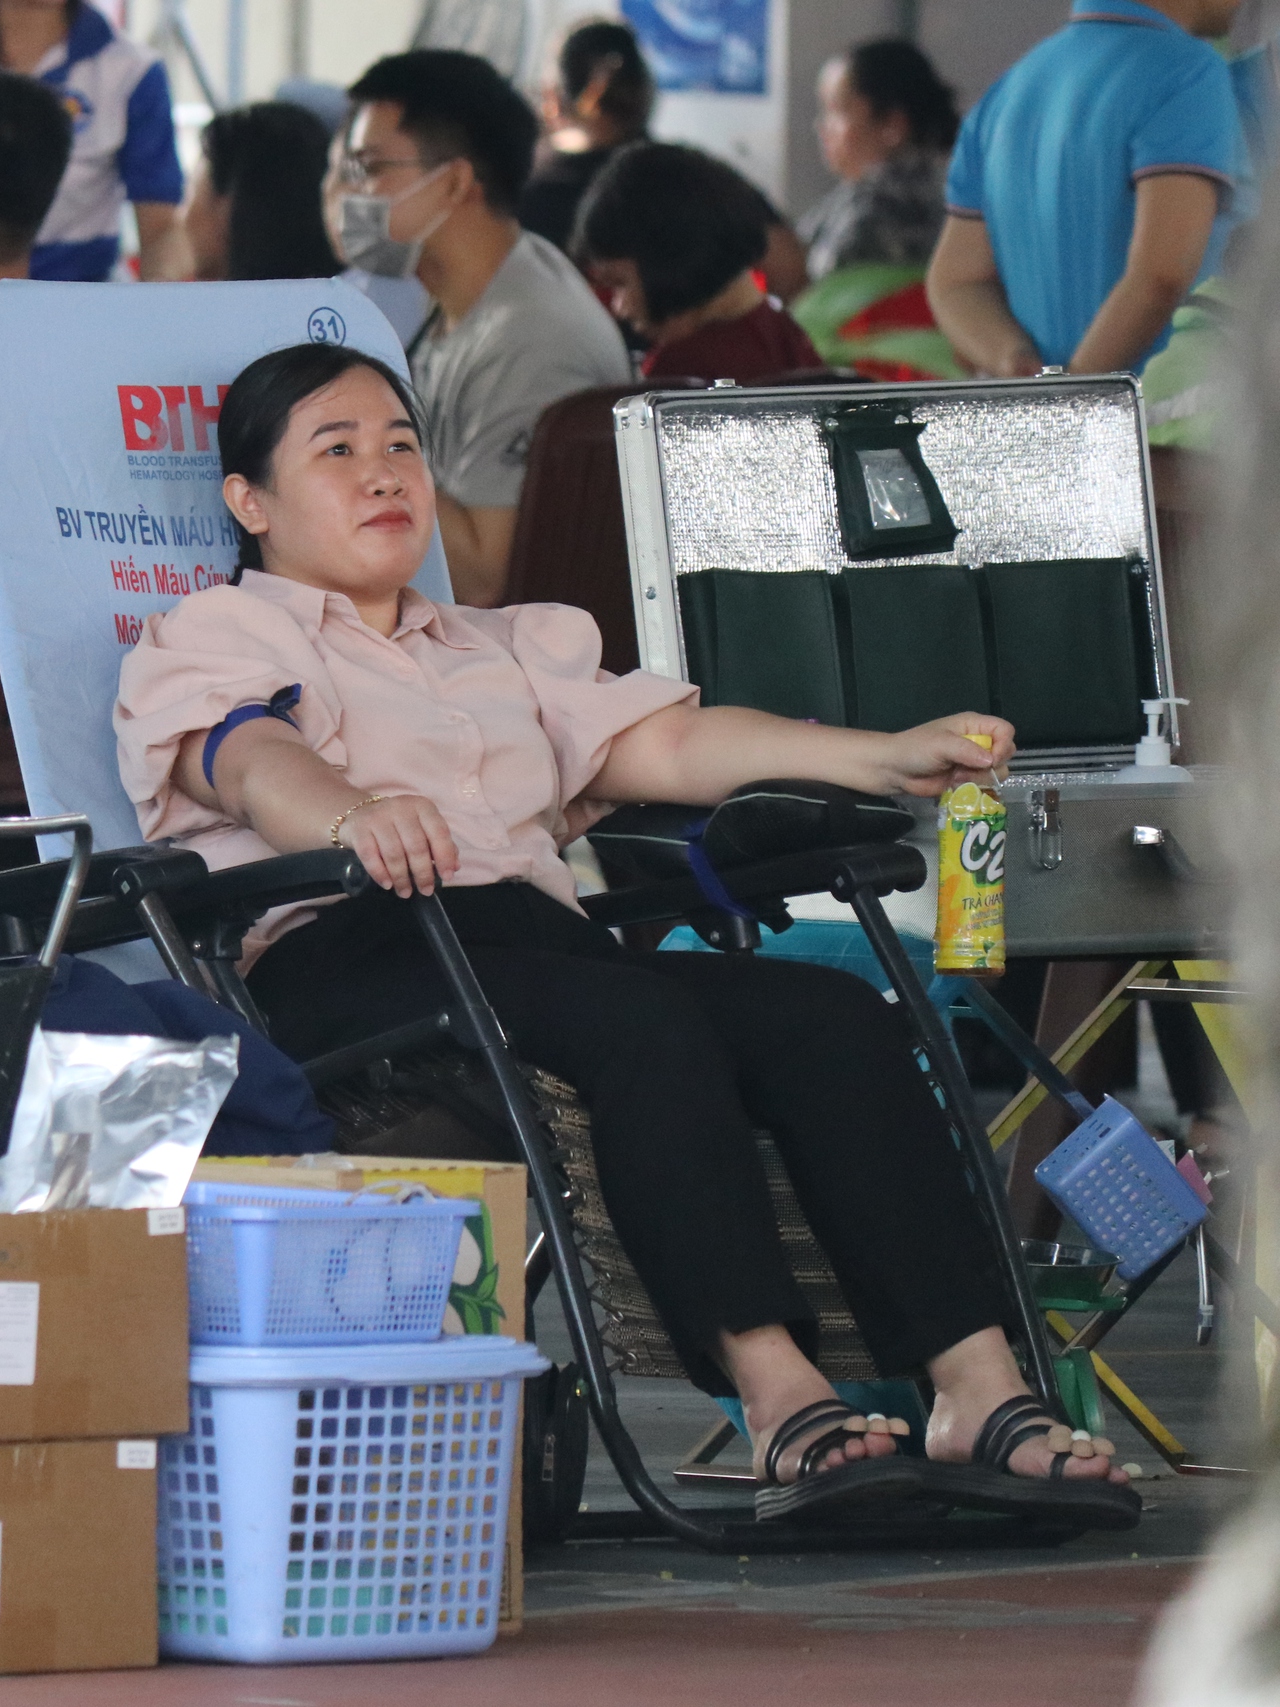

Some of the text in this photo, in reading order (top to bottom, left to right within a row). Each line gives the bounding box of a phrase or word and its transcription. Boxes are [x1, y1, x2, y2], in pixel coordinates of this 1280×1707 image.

[312, 315, 340, 342] 31
[127, 455, 166, 467] BLOOD
[130, 469, 196, 481] HEMATOLOGY
[55, 506, 82, 539] BV
[84, 503, 167, 546] TRUYỀN
[169, 506, 215, 547] MÁU
[110, 555, 151, 594] Hiến
[153, 563, 191, 596] Máu
[961, 820, 1007, 883] C2
[962, 892, 983, 911] TRÀ
